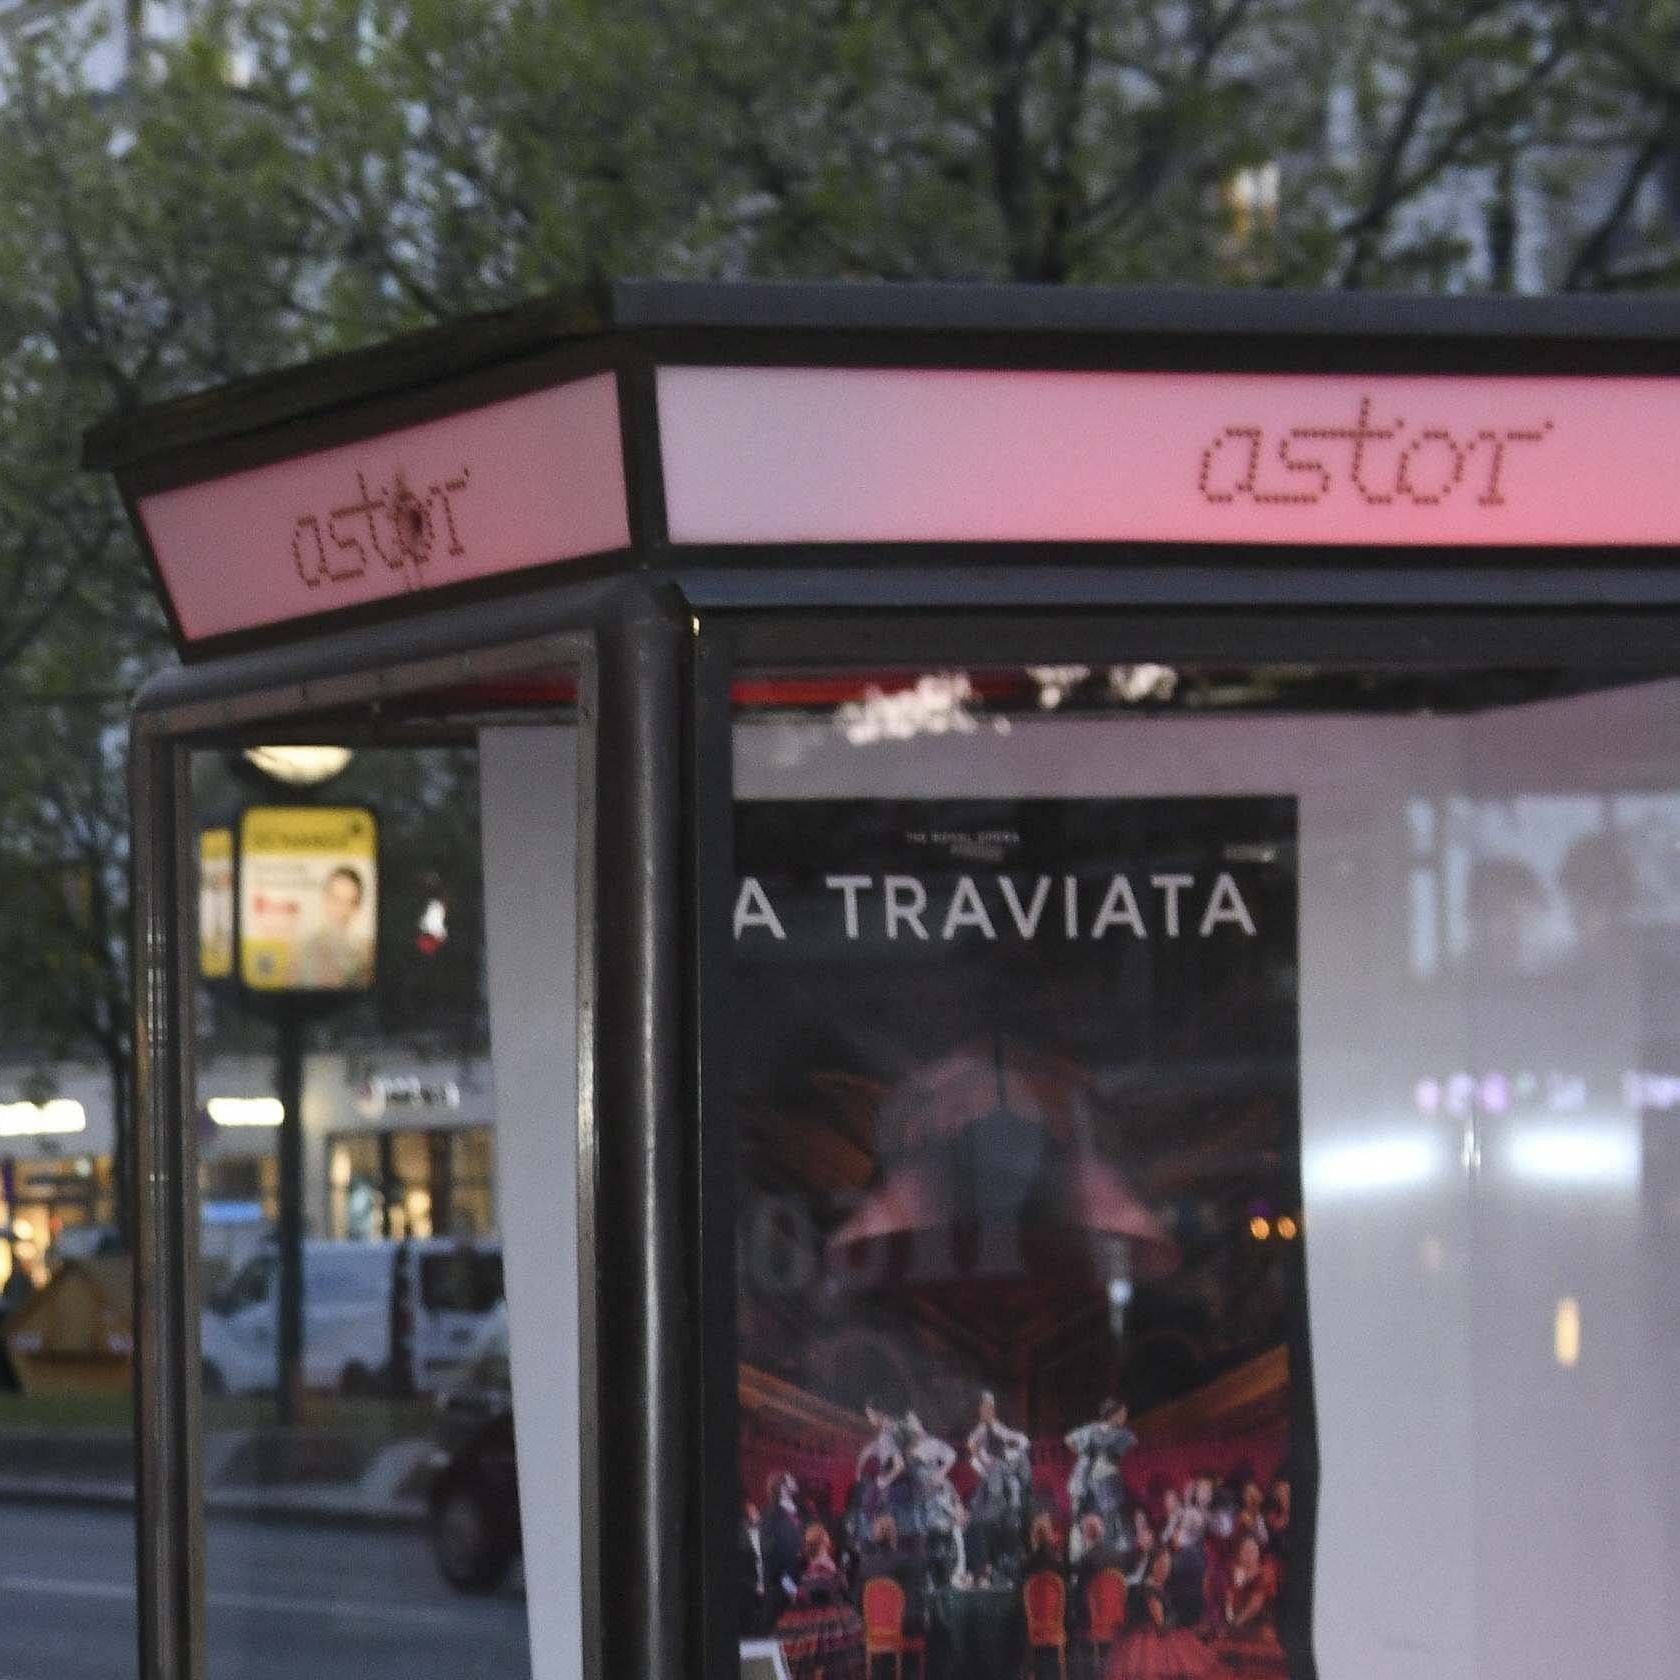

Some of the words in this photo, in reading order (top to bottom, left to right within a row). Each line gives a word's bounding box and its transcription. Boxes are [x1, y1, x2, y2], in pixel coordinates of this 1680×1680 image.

[1199, 397, 1555, 506] astor
[292, 466, 470, 588] astor
[825, 873, 1257, 941] TRAVIATA
